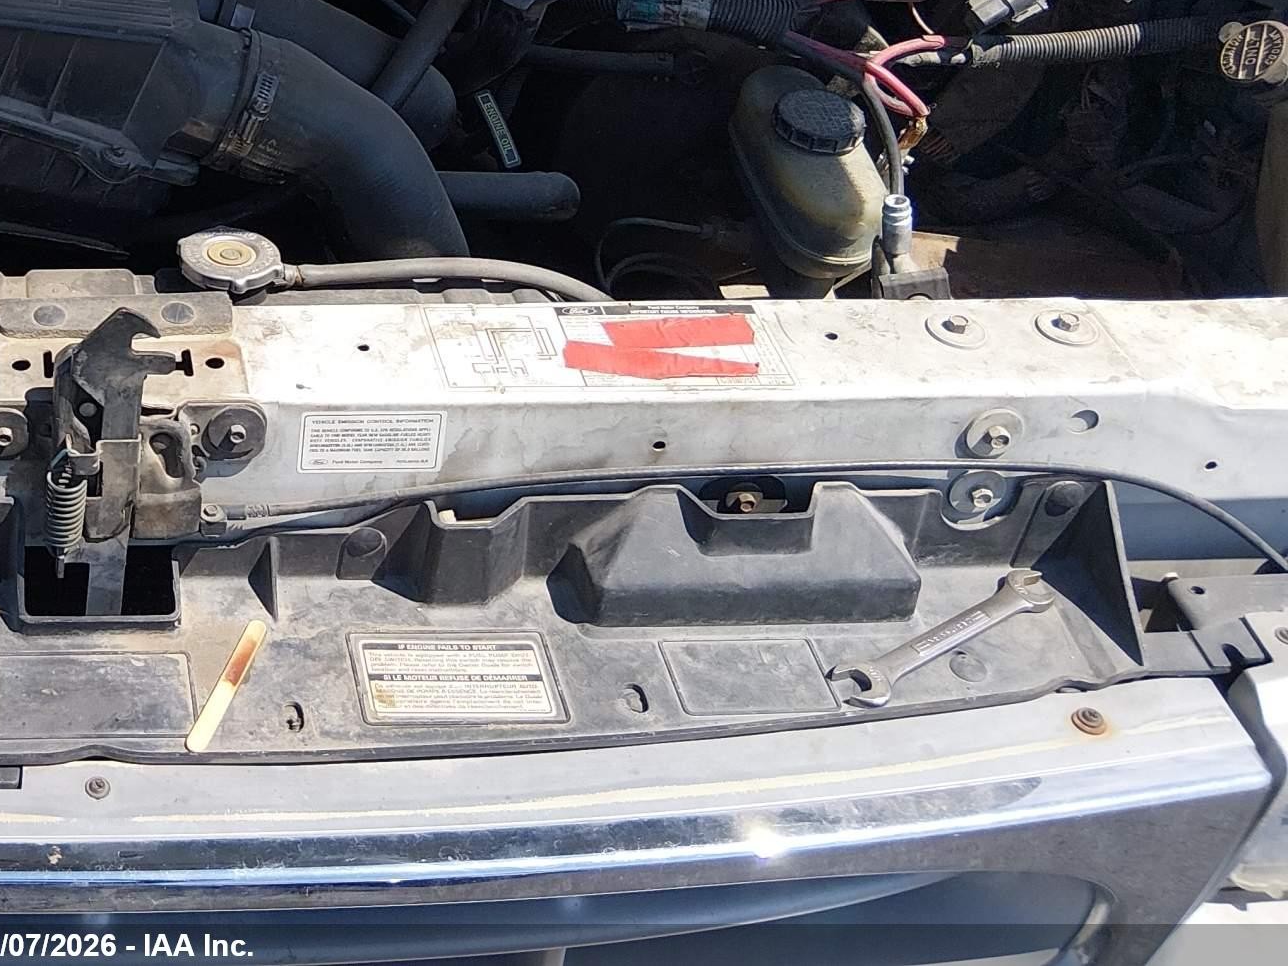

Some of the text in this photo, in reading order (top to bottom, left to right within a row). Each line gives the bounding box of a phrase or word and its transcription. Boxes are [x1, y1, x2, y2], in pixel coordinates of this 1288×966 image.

[1245, 30, 1261, 65] ONLY
[484, 103, 513, 155] ENGINE OIL
